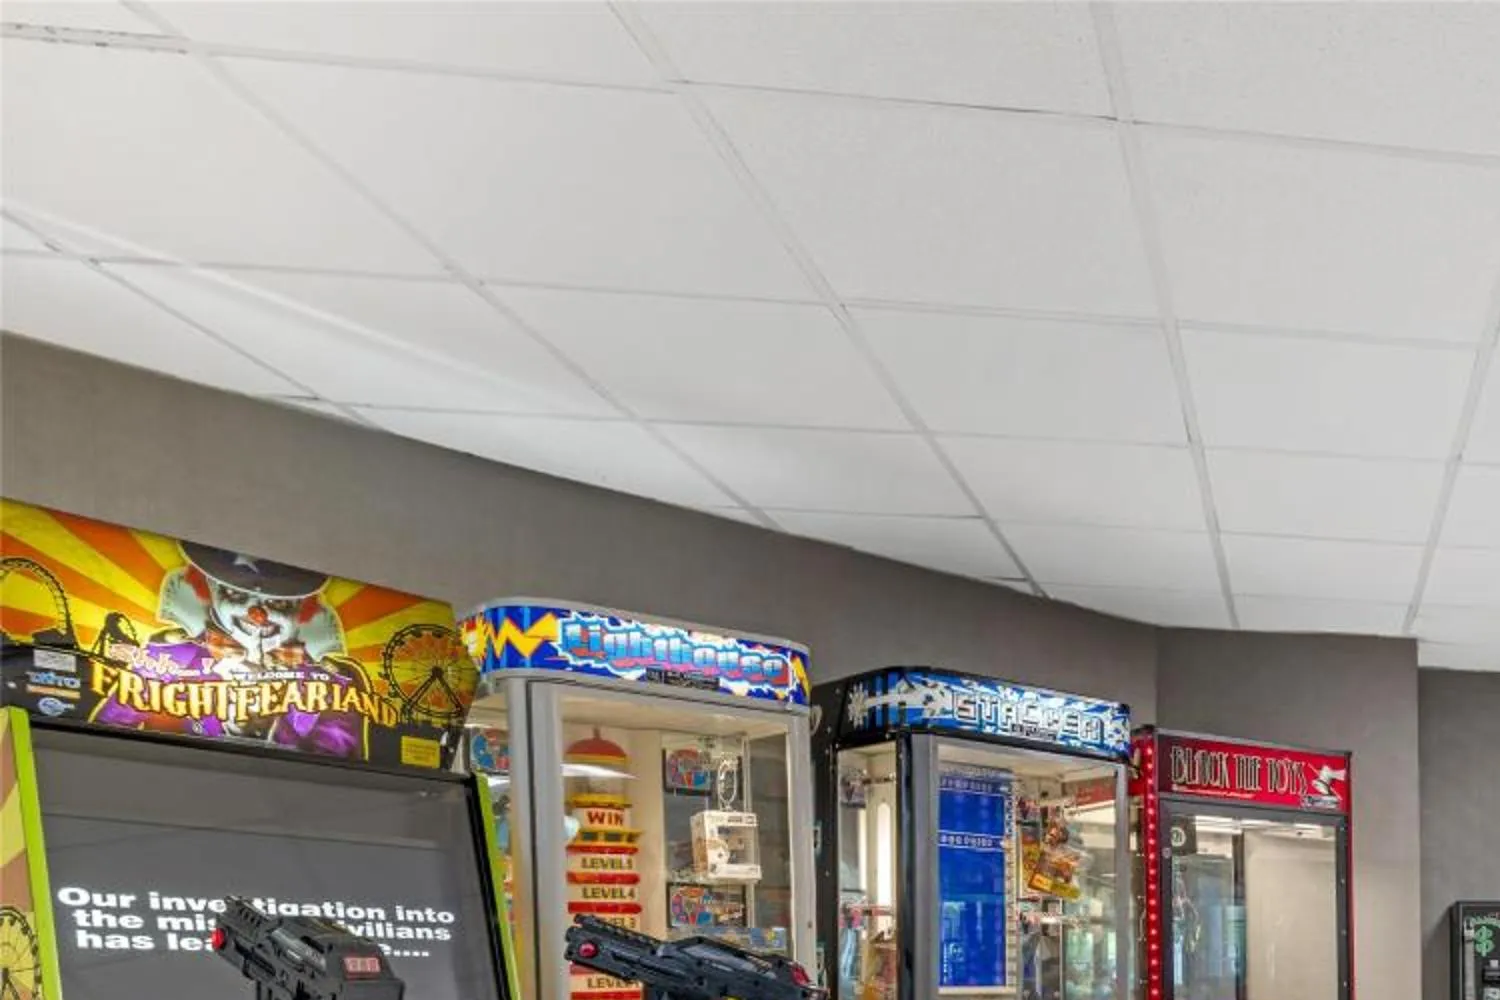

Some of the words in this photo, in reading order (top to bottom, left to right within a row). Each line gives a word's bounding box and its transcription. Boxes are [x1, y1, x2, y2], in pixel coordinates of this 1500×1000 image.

[90, 658, 398, 728] FRIGHTFEARLAND
[954, 690, 1103, 742] STACKER
[586, 811, 624, 826] WIN
[57, 887, 137, 909] Our
[148, 891, 386, 921] invetigation
[395, 905, 455, 924] into
[72, 909, 145, 929] the
[75, 929, 155, 950] has
